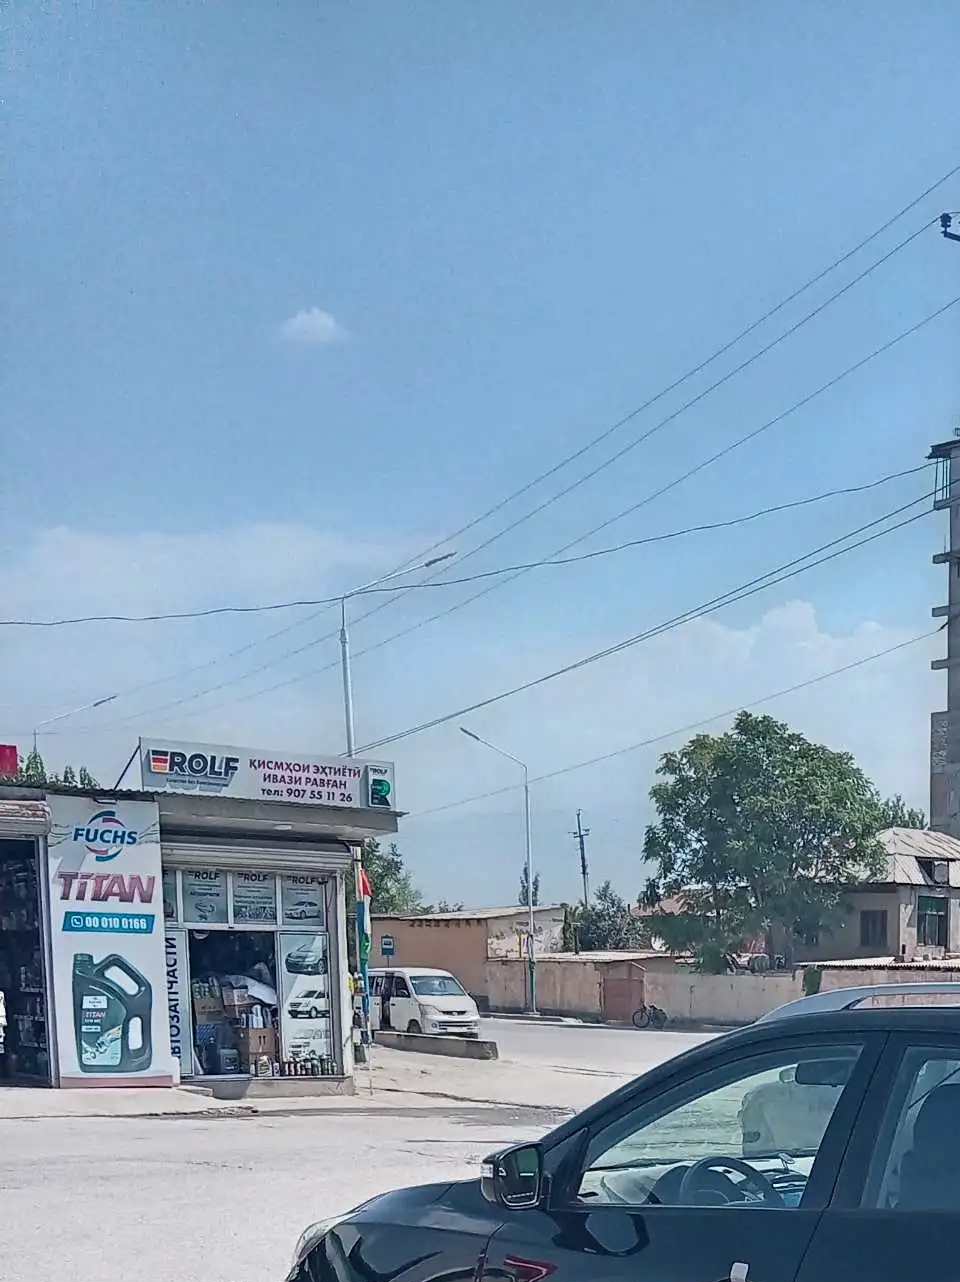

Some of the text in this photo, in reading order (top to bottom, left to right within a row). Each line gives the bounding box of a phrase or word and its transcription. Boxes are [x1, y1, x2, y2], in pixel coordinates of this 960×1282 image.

[168, 751, 240, 778] ROLF
[263, 773, 347, 790] ИВАЗИ РАВҒАН
[261, 788, 353, 802] тел: 907 55 11 26
[73, 827, 138, 845] FUCHS
[194, 871, 220, 880] ROLF
[243, 873, 269, 882] ROLF
[165, 937, 181, 1060] ВТОЗАПЧАСТИ
